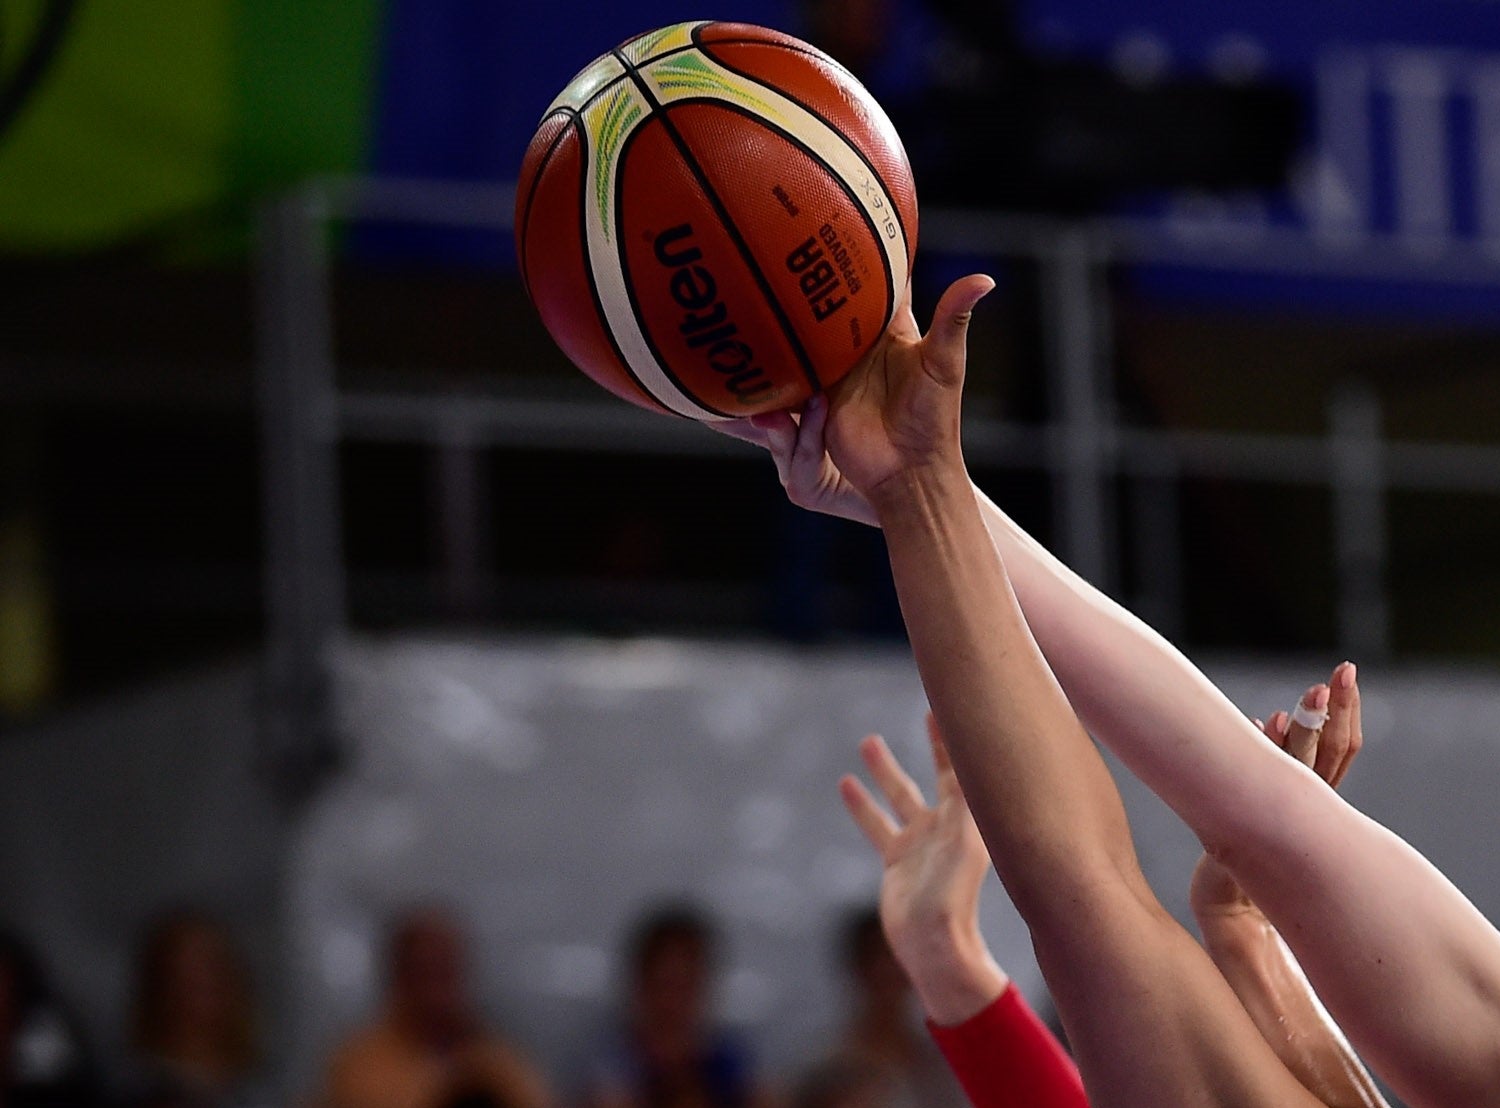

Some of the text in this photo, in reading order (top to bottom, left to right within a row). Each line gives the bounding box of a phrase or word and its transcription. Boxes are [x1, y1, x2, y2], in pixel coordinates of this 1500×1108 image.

[786, 235, 848, 323] FIBA
[819, 223, 862, 295] APPROVED
[653, 221, 779, 405] molten
